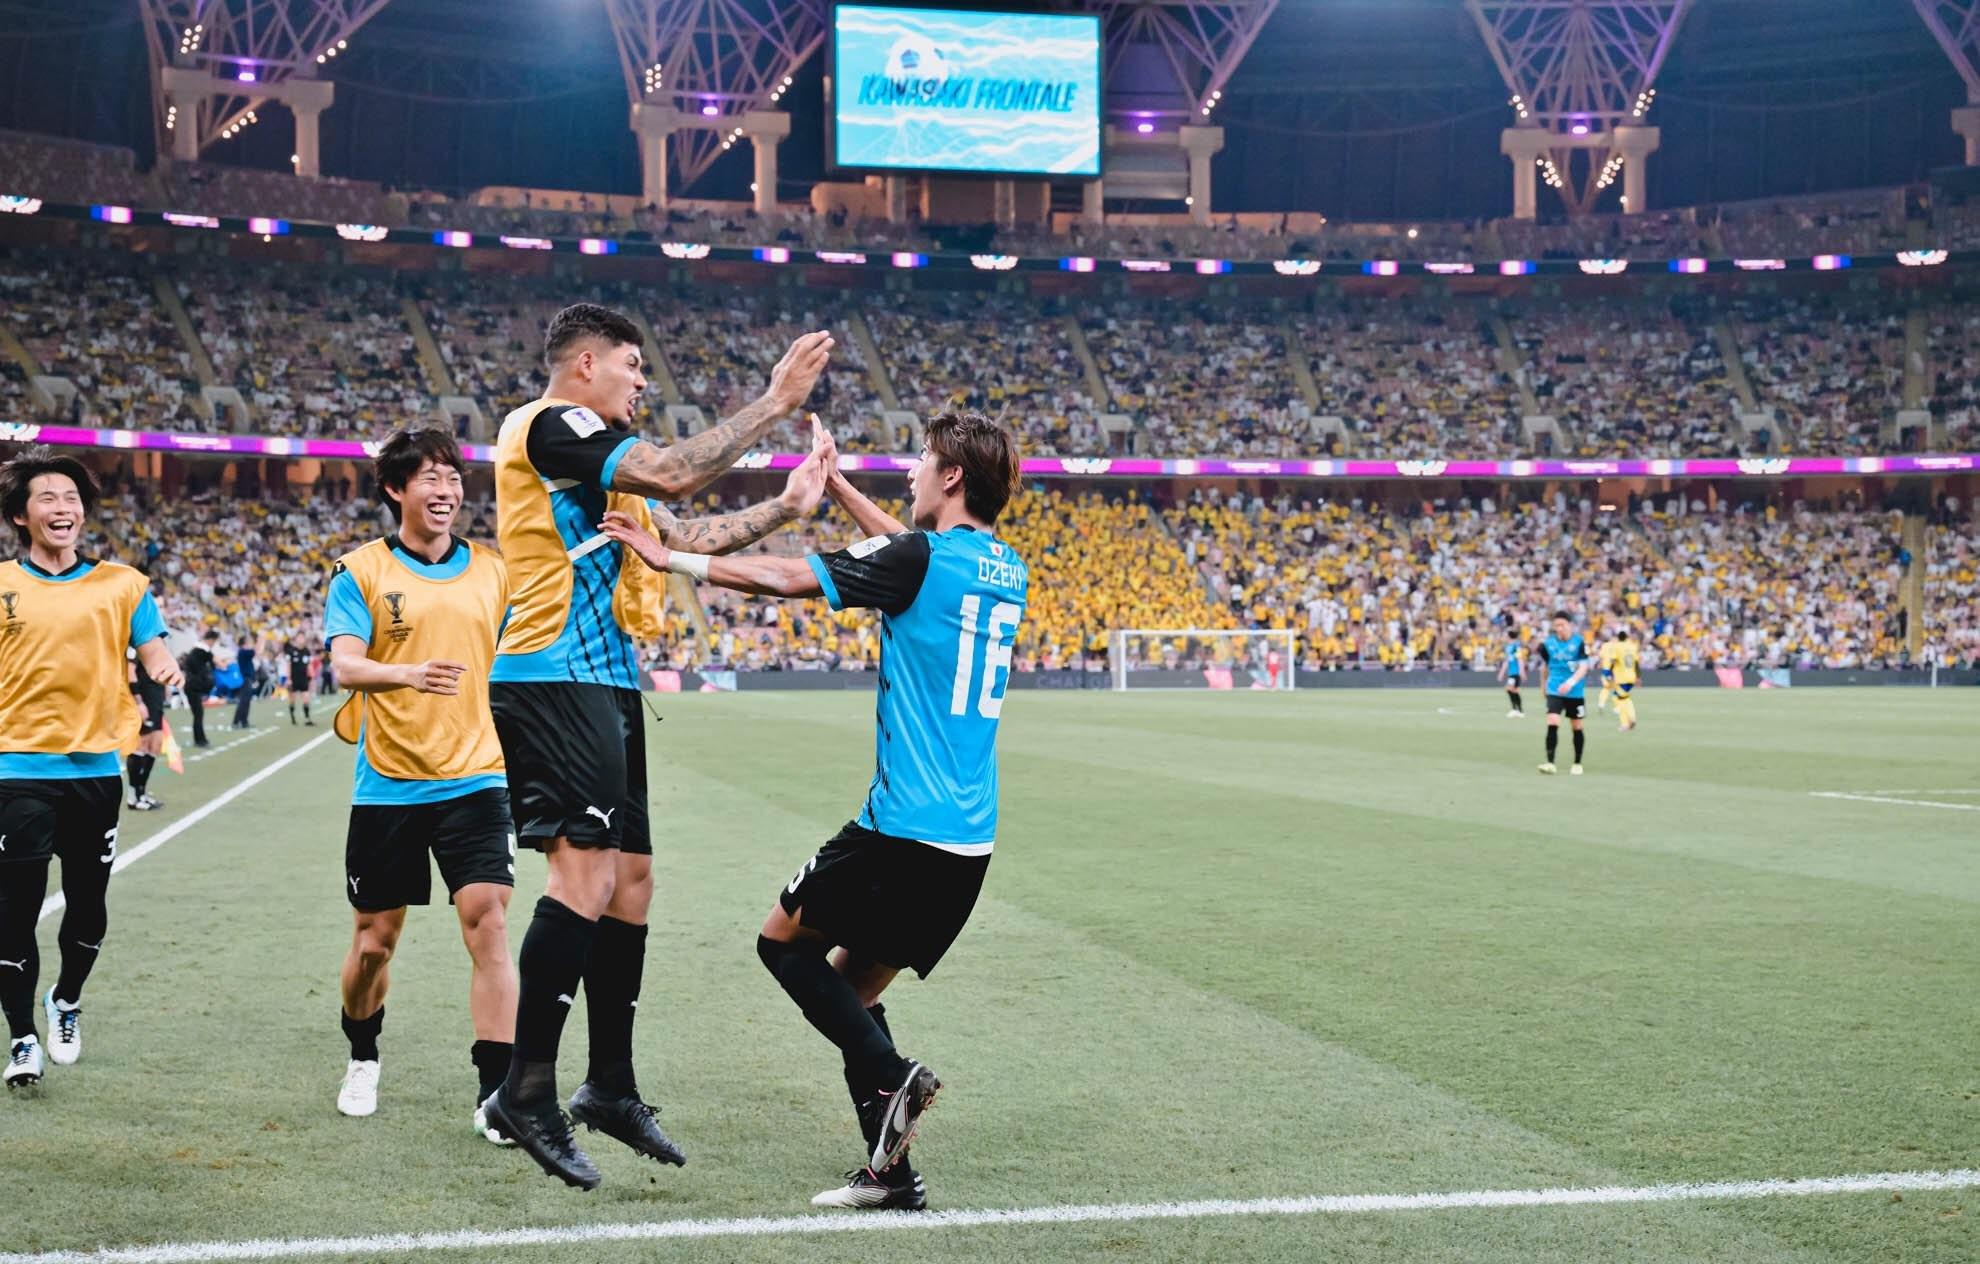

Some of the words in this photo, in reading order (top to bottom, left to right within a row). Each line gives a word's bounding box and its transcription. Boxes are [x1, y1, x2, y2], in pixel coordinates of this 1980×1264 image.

[858, 73, 974, 109] KAWASAKI
[973, 77, 1078, 112] FRONTALE
[950, 594, 1021, 719] 16
